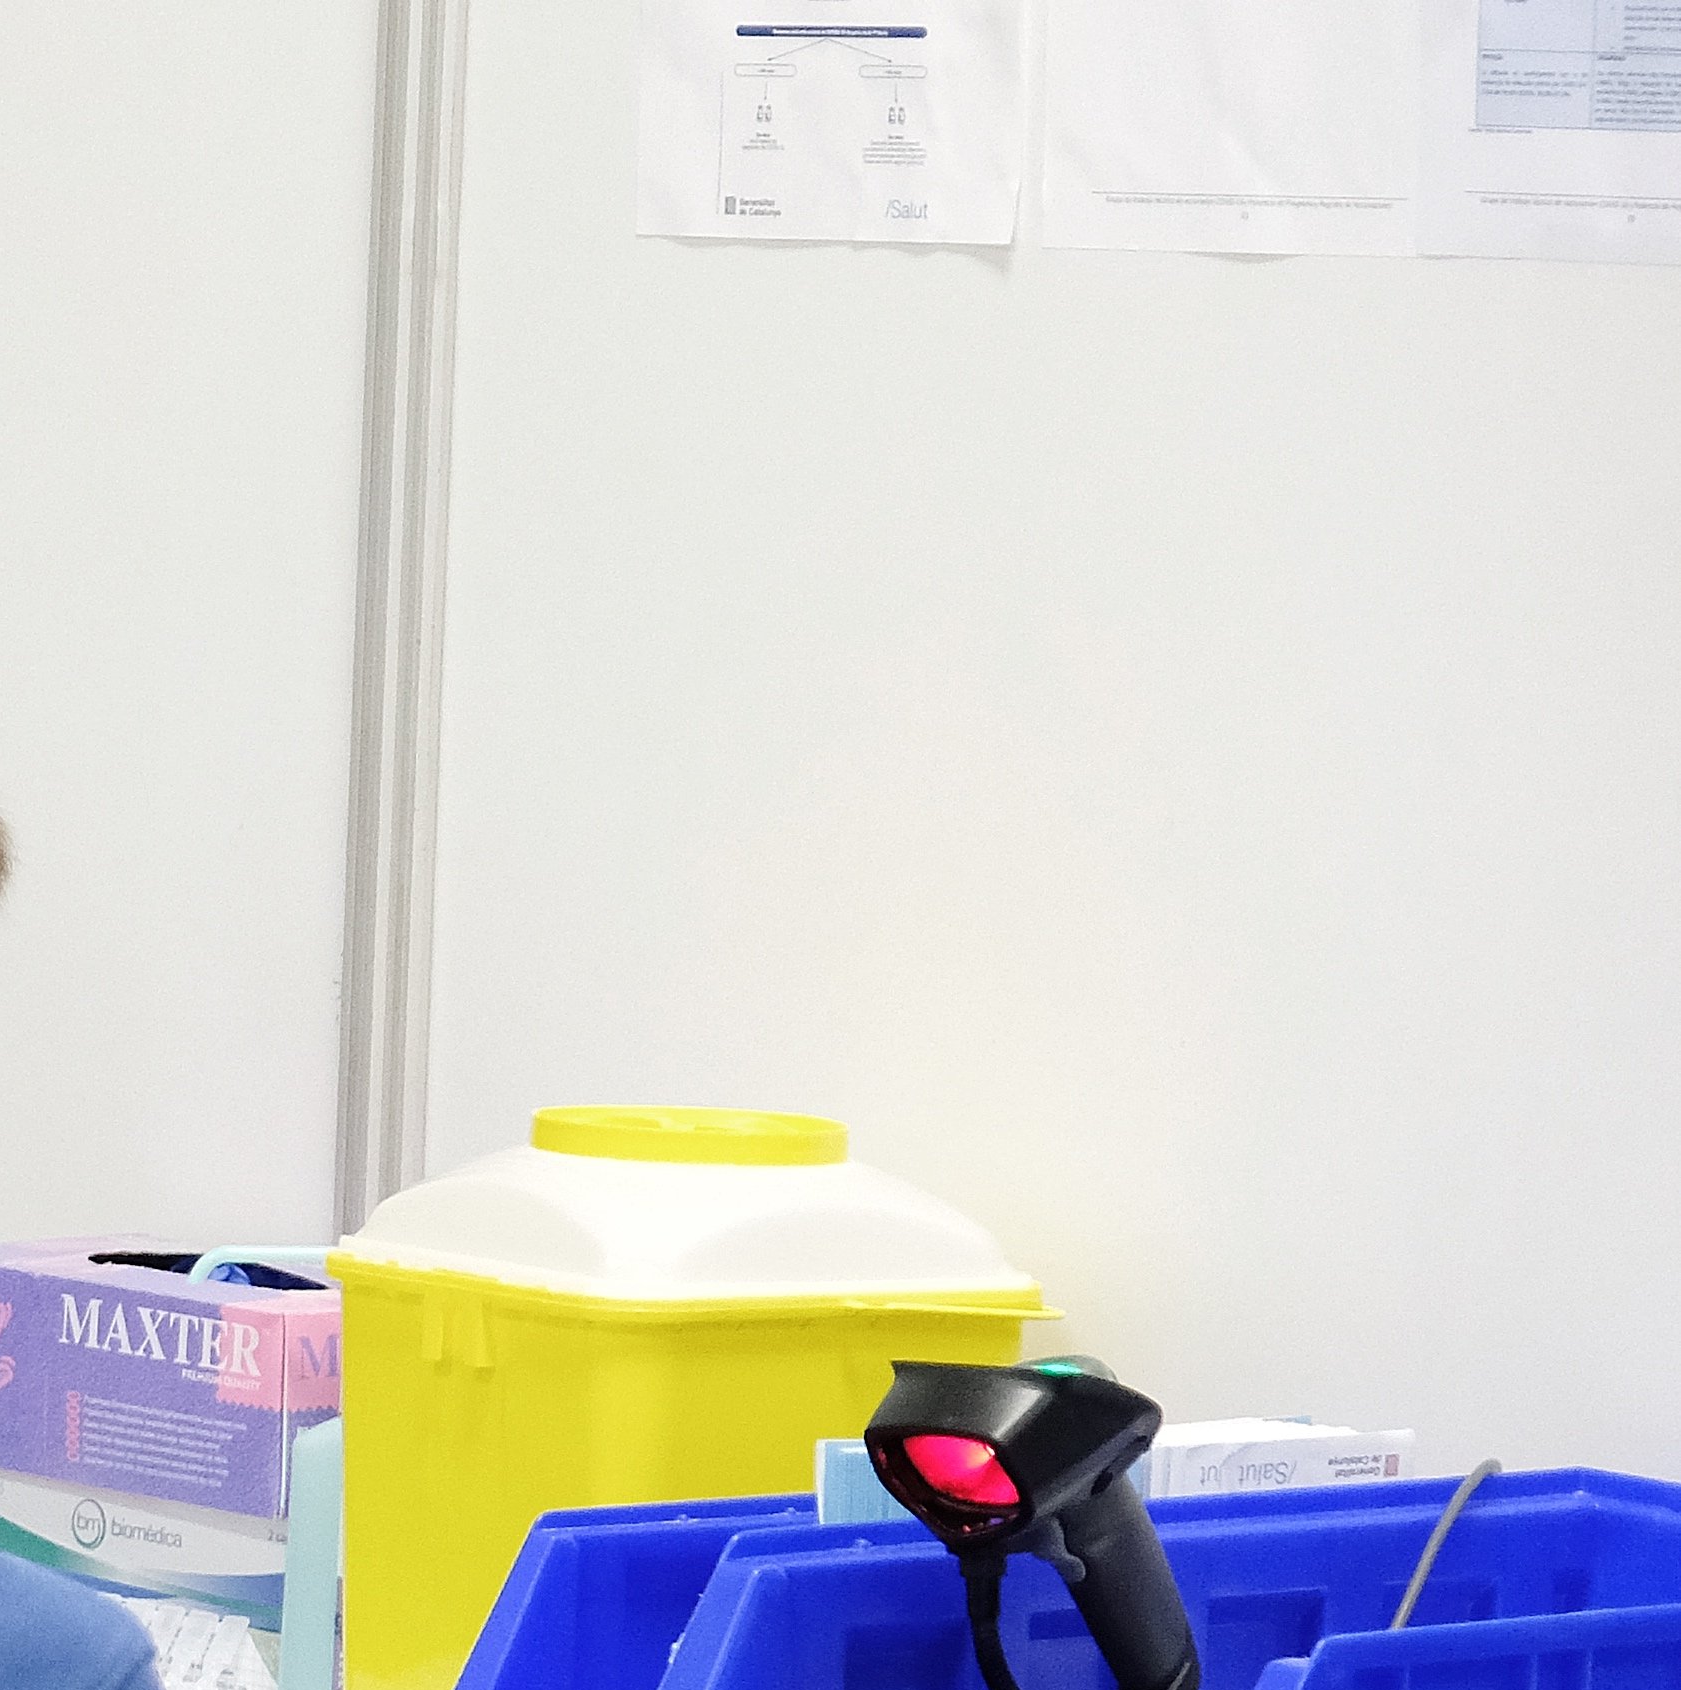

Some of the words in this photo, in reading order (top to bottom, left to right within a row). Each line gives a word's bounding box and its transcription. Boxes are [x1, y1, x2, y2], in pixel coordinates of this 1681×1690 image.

[58, 1293, 262, 1378] MAXTER
[181, 1368, 218, 1385] PREMIUM
[223, 1375, 261, 1391] QUALITY
